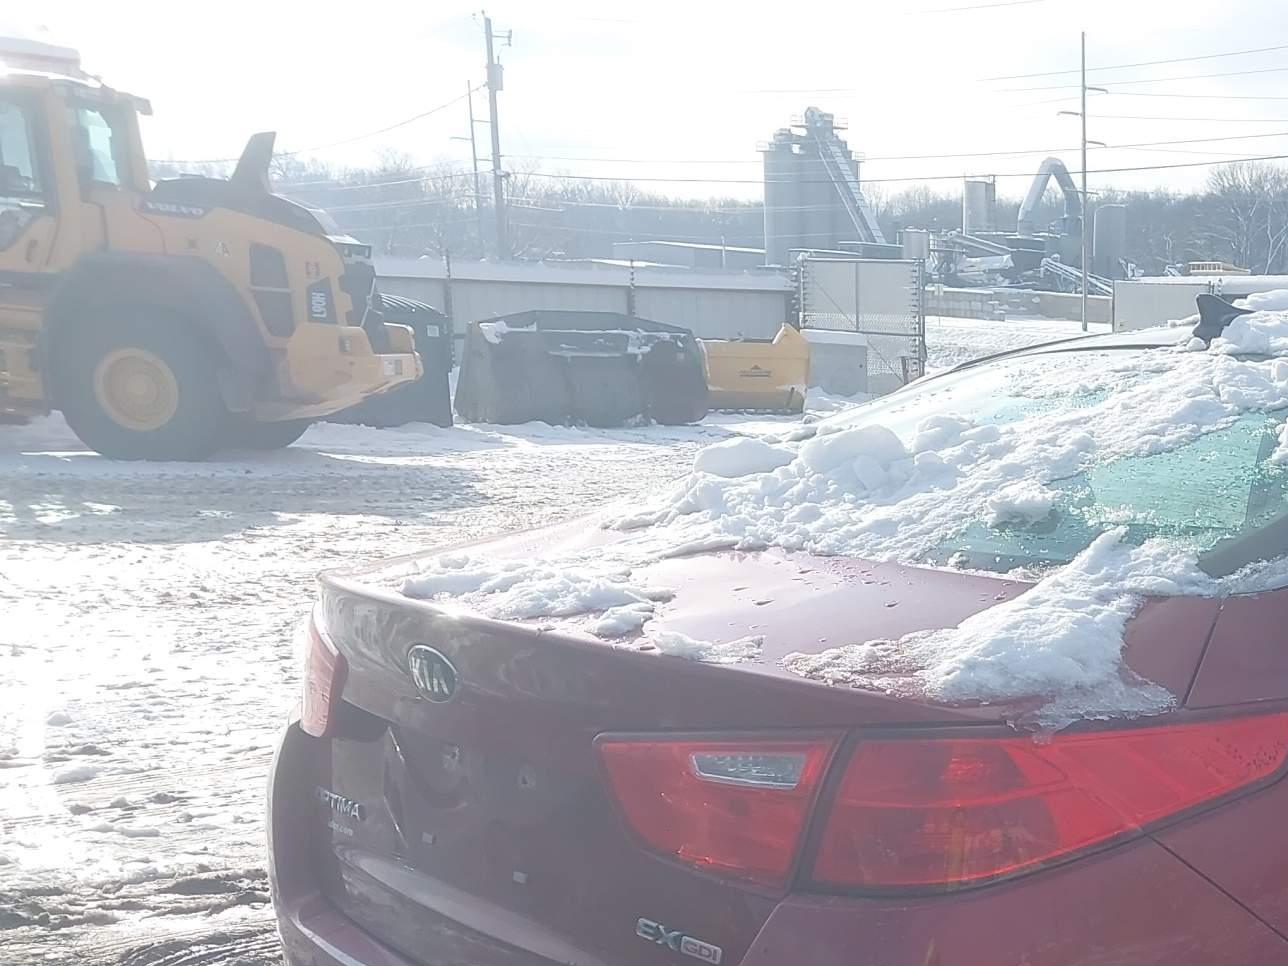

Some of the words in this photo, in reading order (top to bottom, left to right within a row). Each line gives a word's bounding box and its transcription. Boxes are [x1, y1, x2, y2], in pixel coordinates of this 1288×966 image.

[145, 201, 205, 216] VOLVO
[410, 655, 450, 696] KIA
[636, 917, 682, 951] EX
[683, 939, 721, 963] GDI
